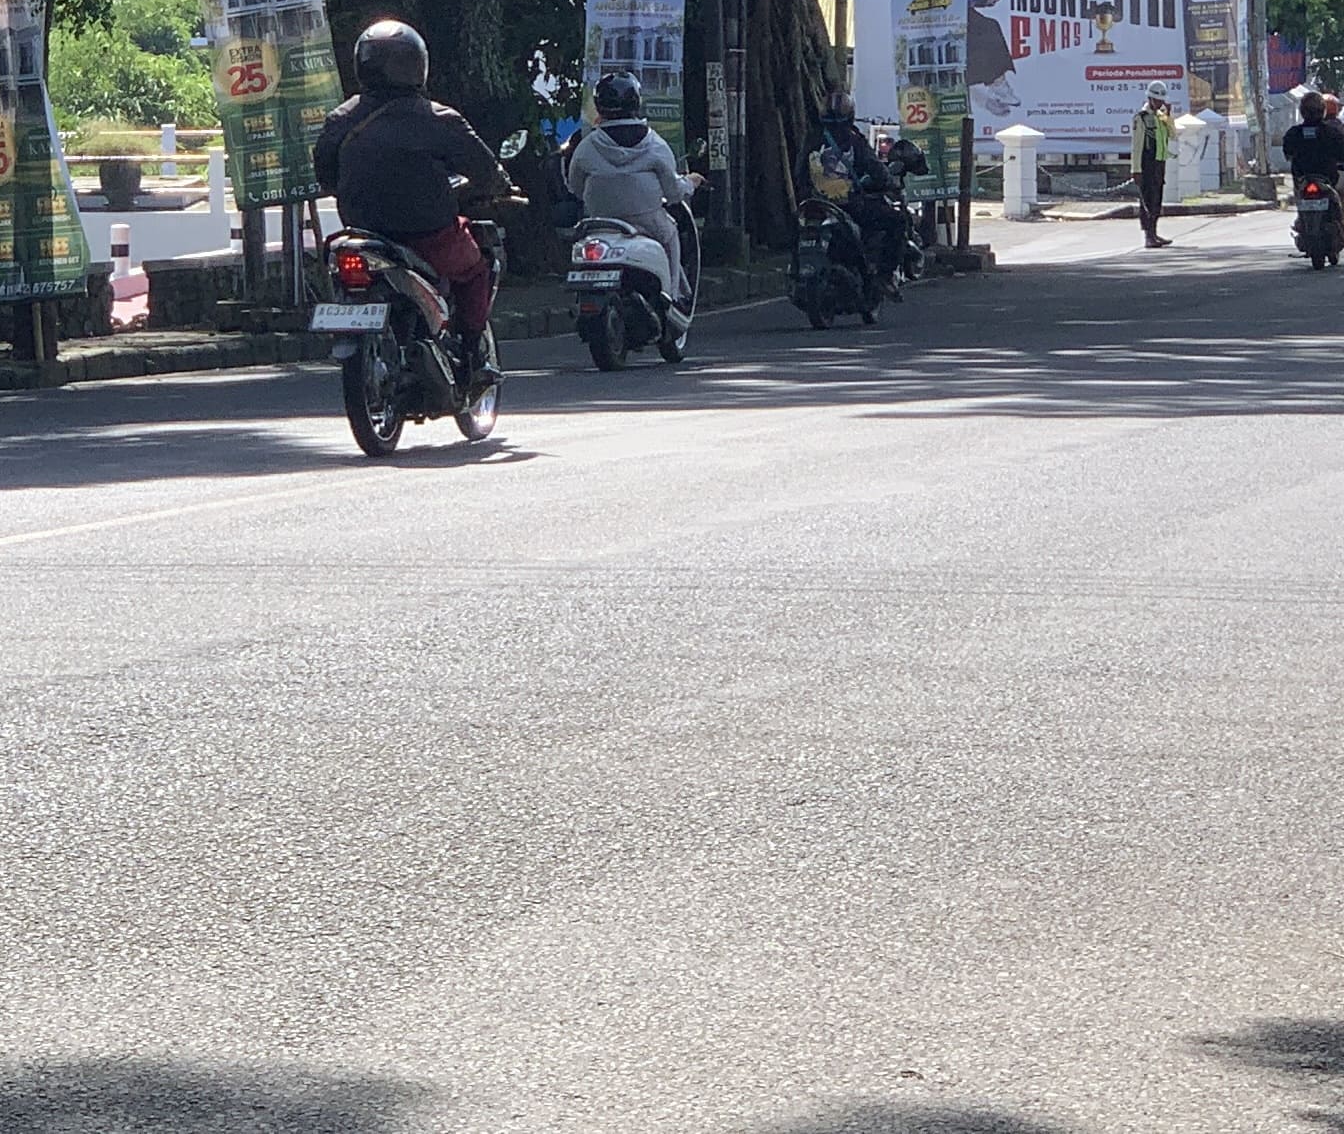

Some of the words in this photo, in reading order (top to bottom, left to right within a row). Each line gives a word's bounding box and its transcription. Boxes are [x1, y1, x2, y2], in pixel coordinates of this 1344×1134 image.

[1010, 16, 1081, 60] EMAS
[229, 45, 262, 56] EXTRA
[290, 56, 334, 72] KAMPUS
[228, 62, 267, 96] 25
[907, 104, 928, 124] 25
[290, 186, 305, 197] 42
